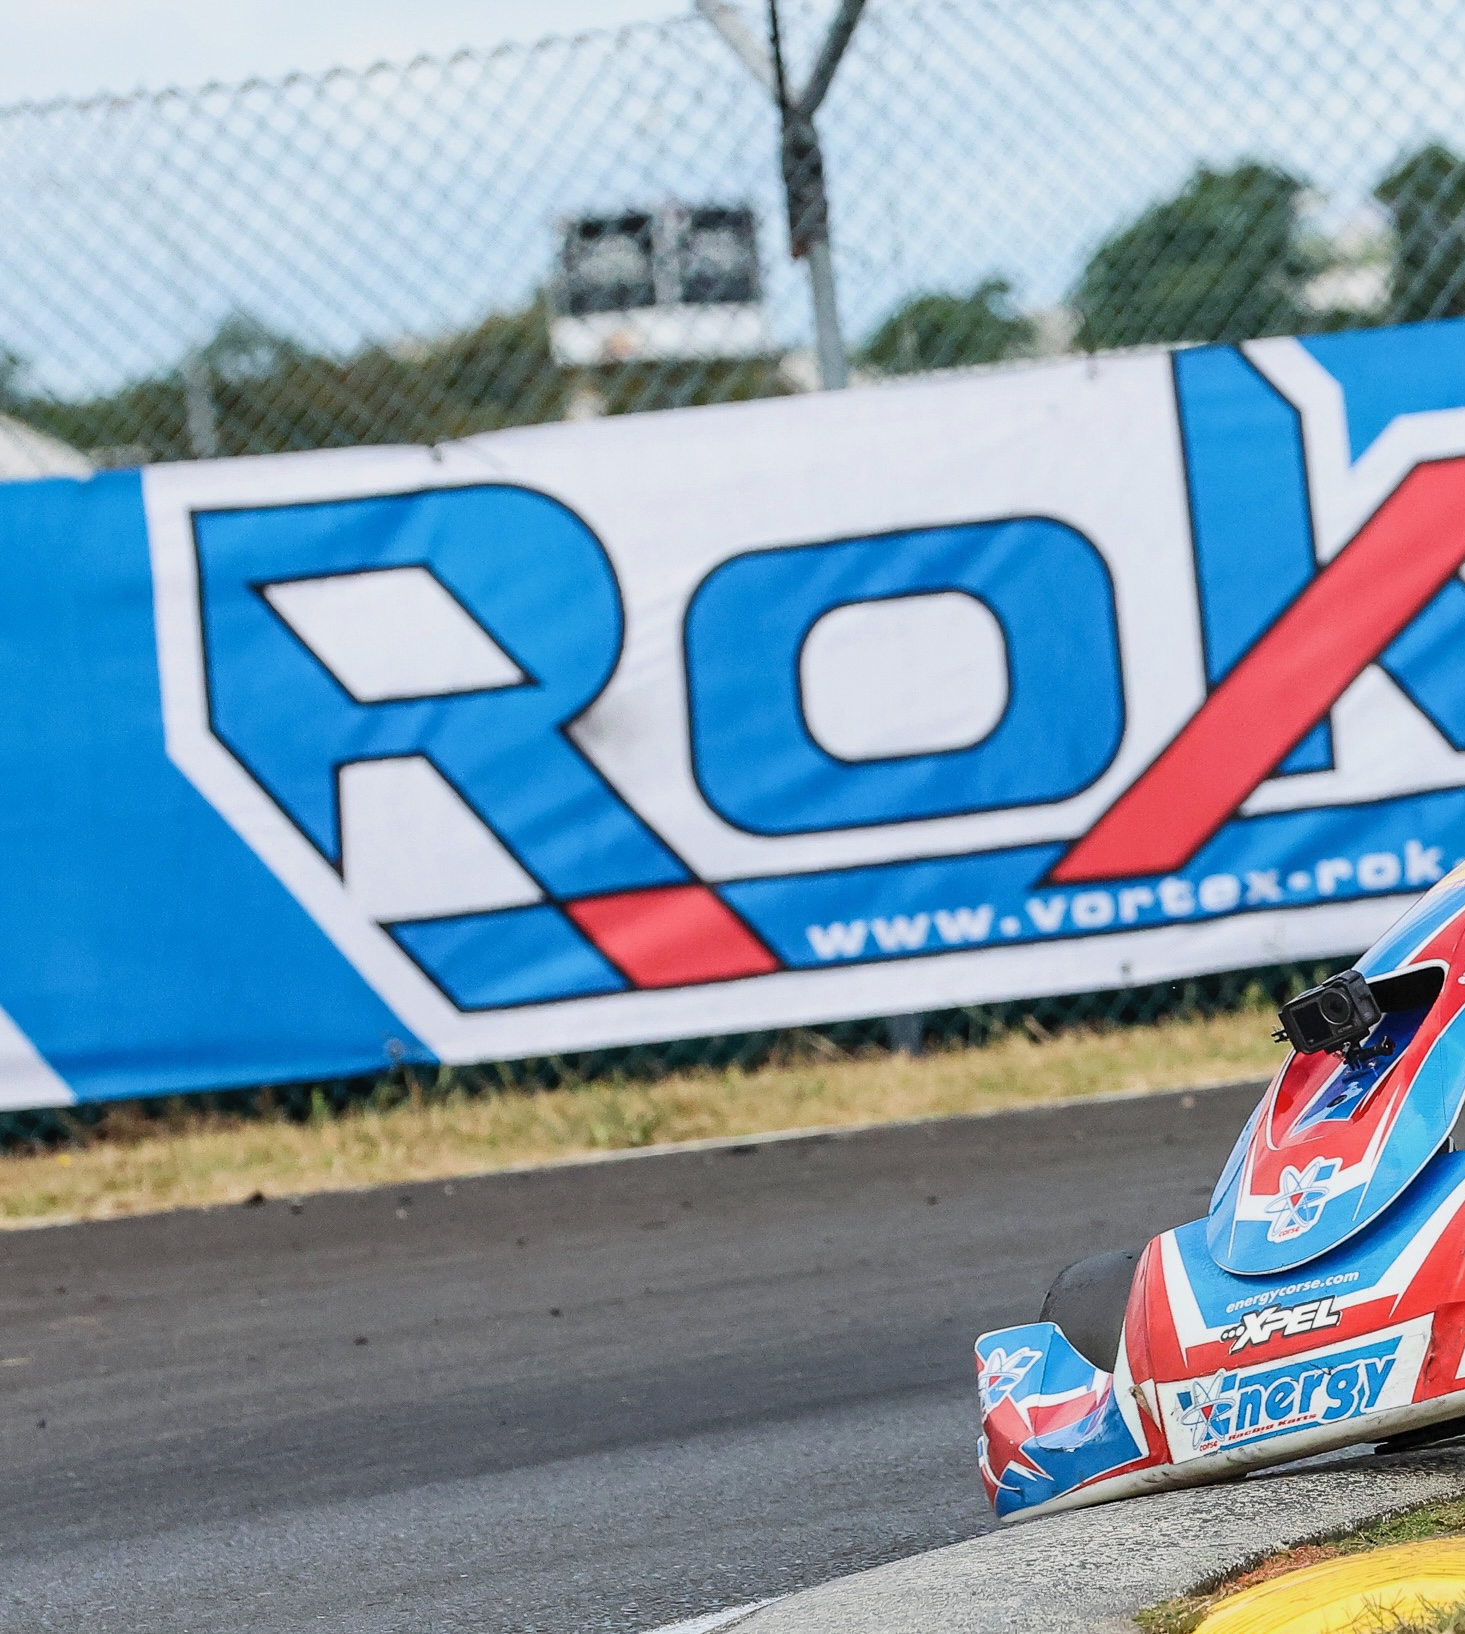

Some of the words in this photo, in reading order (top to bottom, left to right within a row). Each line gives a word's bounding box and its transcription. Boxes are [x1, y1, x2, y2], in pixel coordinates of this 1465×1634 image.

[807, 839, 1462, 961] www.vortex-rok
[1278, 1226, 1300, 1237] corse
[1226, 1271, 1360, 1313] energycorse.com
[1228, 1294, 1341, 1355] XPEL
[1190, 1358, 1397, 1442] Energy
[1277, 1413, 1318, 1427] Karts
[1199, 1440, 1218, 1451] corse
